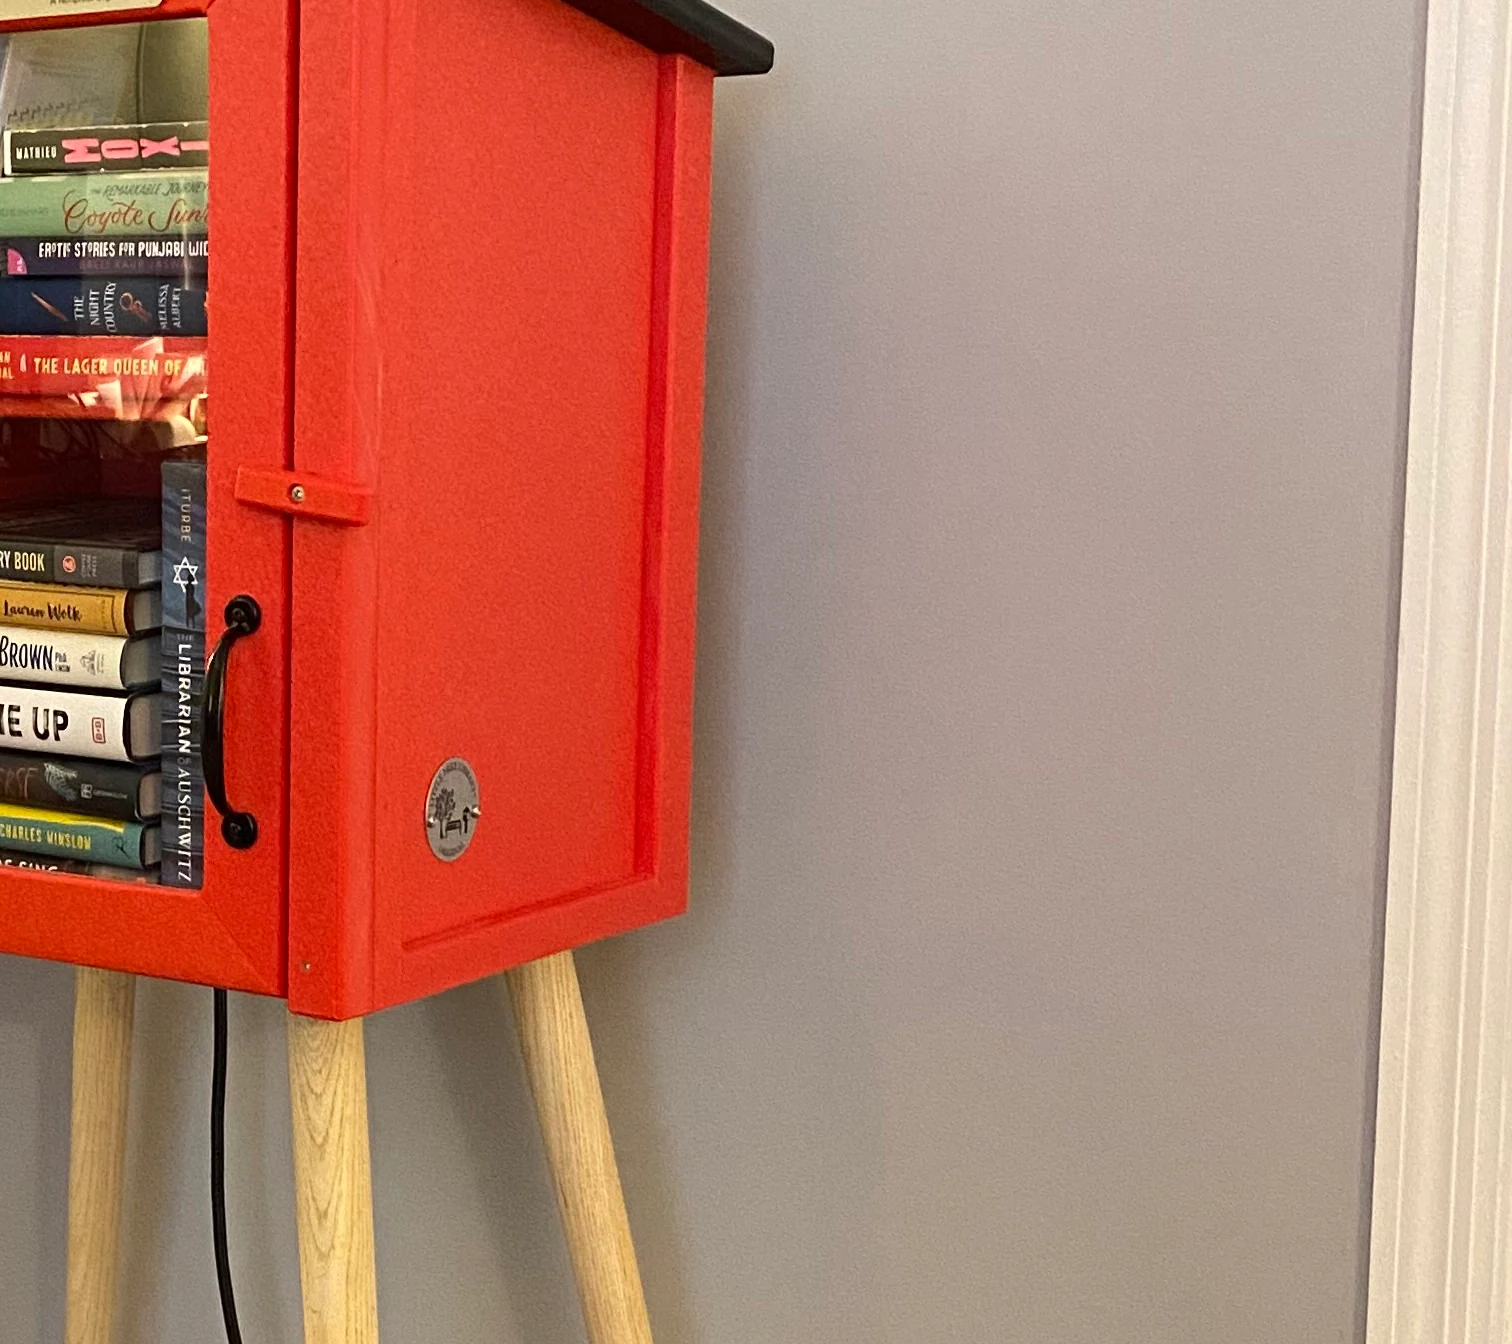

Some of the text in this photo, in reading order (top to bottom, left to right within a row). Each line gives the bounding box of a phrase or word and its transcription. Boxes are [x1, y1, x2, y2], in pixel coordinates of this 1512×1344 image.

[16, 146, 57, 160] MATHIEU
[63, 190, 144, 234] Coyote
[74, 241, 115, 257] STORIES
[119, 241, 135, 257] FOR
[138, 239, 184, 257] PUNJABI
[74, 295, 85, 321] THE
[90, 288, 100, 326] NIGHT
[34, 356, 181, 374] THE LAGER QUEEN OF
[180, 488, 192, 542] ITURBE
[14, 552, 45, 571] BOOK
[0, 636, 53, 671] BROWN
[32, 706, 69, 742] UP
[176, 644, 193, 882] LIBRARIAN AUSCHWITZ
[0, 821, 42, 843] CHARLES
[46, 830, 92, 850] WINSLOW
